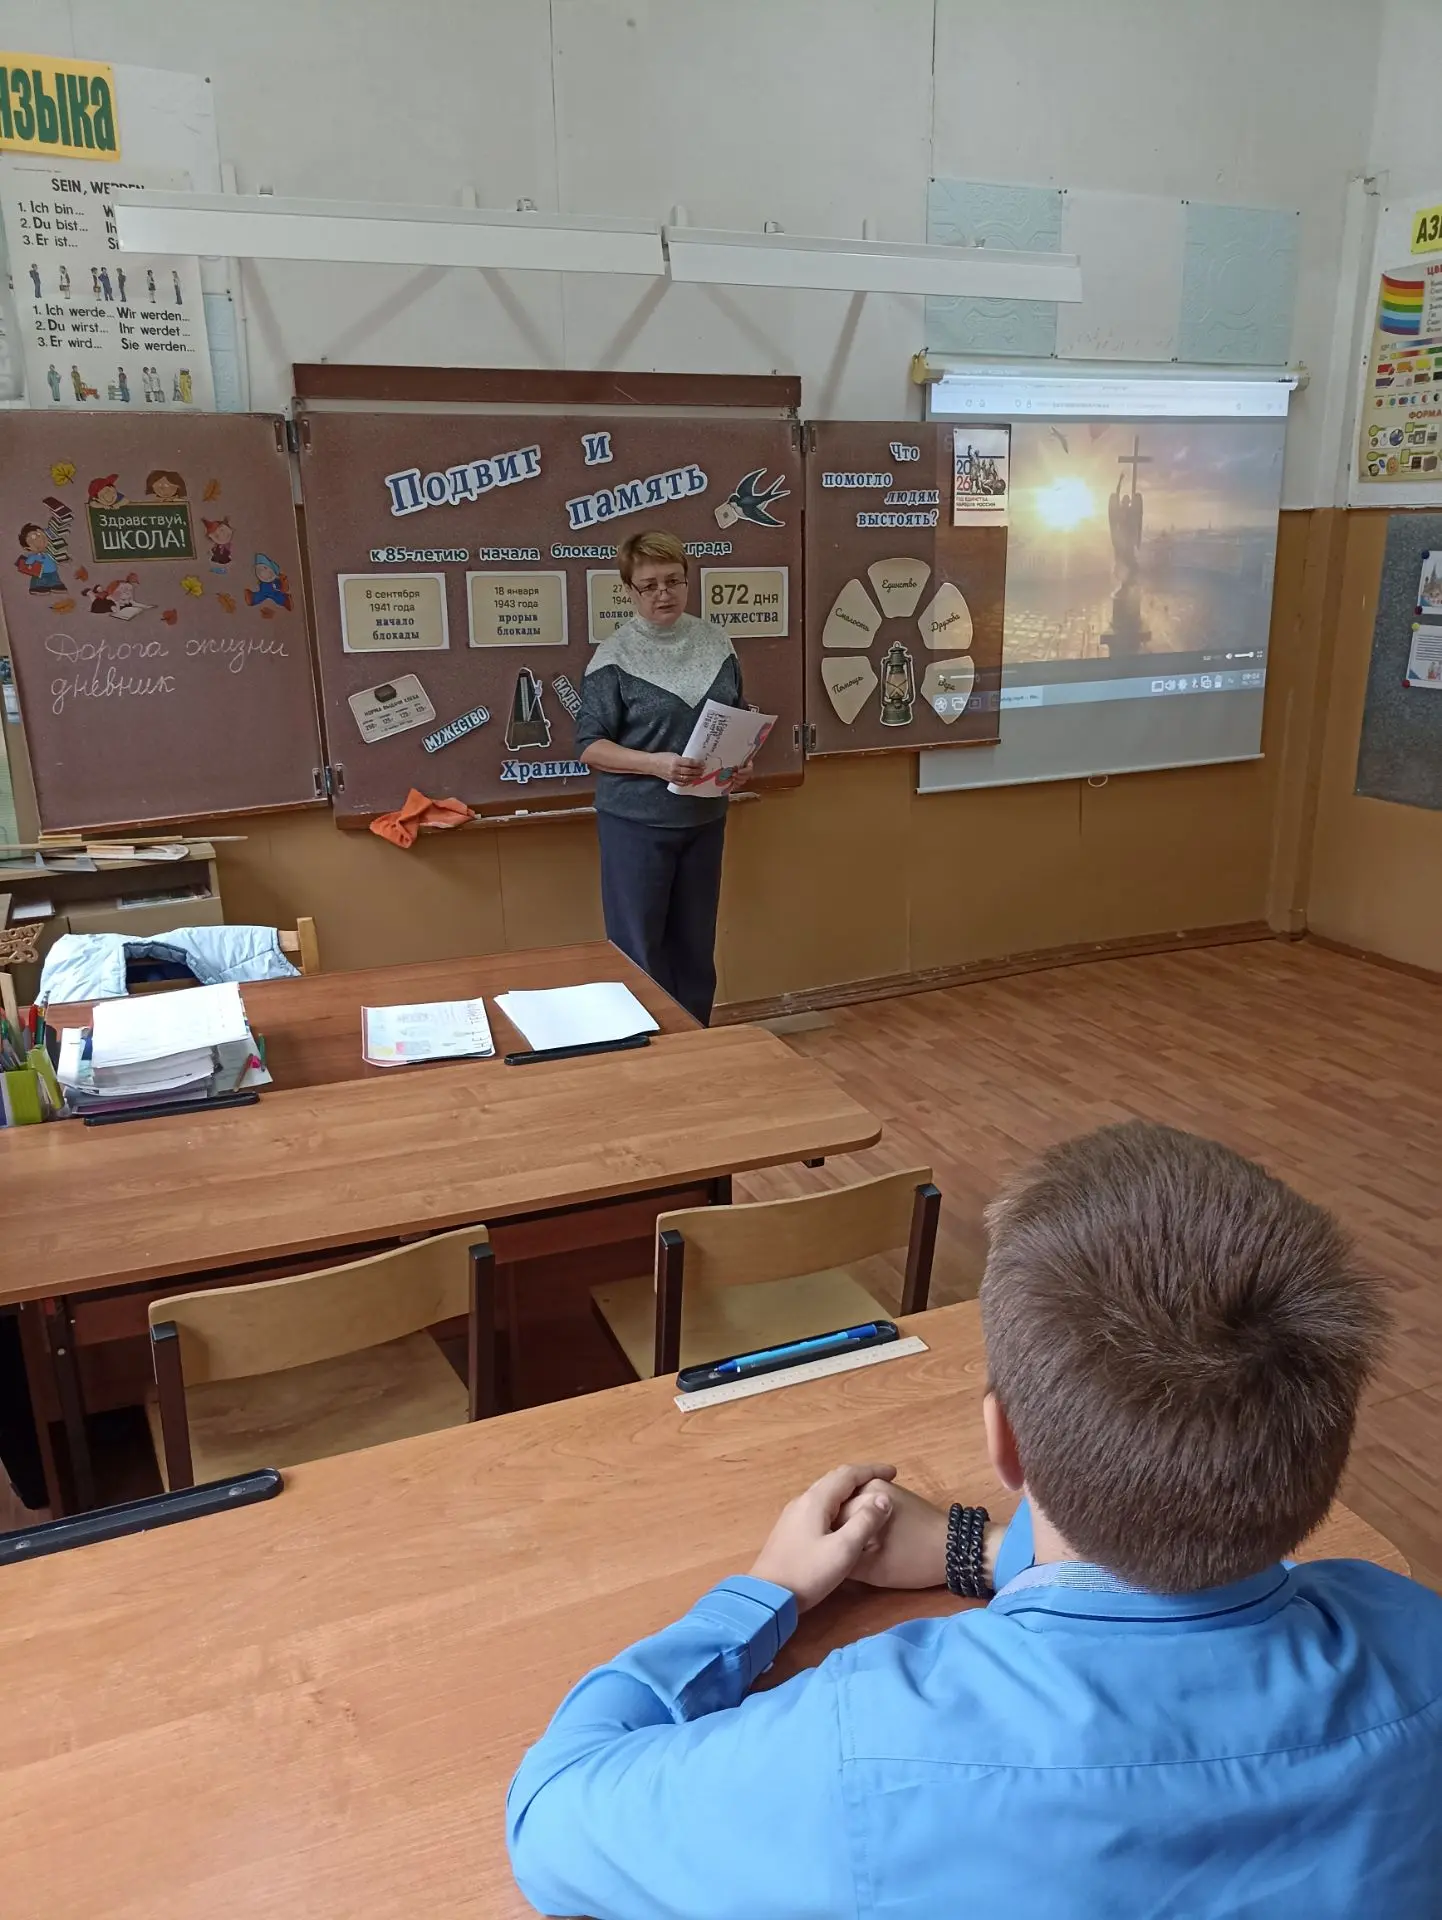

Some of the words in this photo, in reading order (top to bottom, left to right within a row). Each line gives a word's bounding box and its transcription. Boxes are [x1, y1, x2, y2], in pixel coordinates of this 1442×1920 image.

[51, 178, 87, 195] SEIN,
[17, 202, 26, 212] 1.
[30, 201, 49, 214] Ich
[20, 218, 31, 229] 2.
[33, 217, 50, 230] Du
[106, 221, 117, 234] Ih
[1416, 214, 1442, 244] АЗ
[23, 235, 33, 245] 3.
[36, 234, 49, 246] Er
[108, 238, 119, 250] Si
[33, 305, 41, 315] 1.
[45, 304, 64, 316] Ich
[117, 307, 136, 319] Wir
[35, 321, 46, 331] 2.
[48, 319, 65, 331] Du
[119, 322, 135, 335] Ihr
[38, 337, 48, 347] 3.
[50, 336, 63, 347] Er
[121, 338, 140, 350] Sie
[891, 444, 918, 459] Что
[956, 460, 971, 475] 20
[389, 448, 539, 513] Подвиг
[824, 474, 891, 486] помогло
[956, 476, 971, 491] 26
[569, 467, 705, 526] память
[886, 491, 937, 504] людям
[99, 514, 187, 529] Здравствуй,
[858, 510, 937, 525] выстоять?
[101, 530, 186, 550] ШКОЛА!
[386, 548, 468, 561] 85-летию
[480, 548, 539, 560] начала
[365, 589, 372, 599] 8
[375, 589, 420, 600] сентября
[494, 586, 504, 596] 18
[507, 588, 539, 596] января
[612, 584, 622, 593] 27
[711, 584, 749, 605] 872
[753, 594, 778, 606] дня
[494, 600, 515, 608] 1943
[612, 596, 632, 605] 1944
[370, 603, 390, 612] 1941
[393, 604, 415, 612] года
[499, 615, 538, 624] прорыв
[600, 611, 633, 619] полное
[710, 610, 778, 629] мужества
[376, 618, 414, 626] начало
[372, 630, 420, 640] блокады
[497, 626, 540, 635] блокады
[44, 633, 169, 678] Дорога
[185, 637, 289, 673] жизни
[50, 663, 176, 715] дневник
[555, 678, 580, 717] НАДЕ
[425, 708, 487, 750] МУЖЕСТВО
[502, 761, 588, 781] Храним
